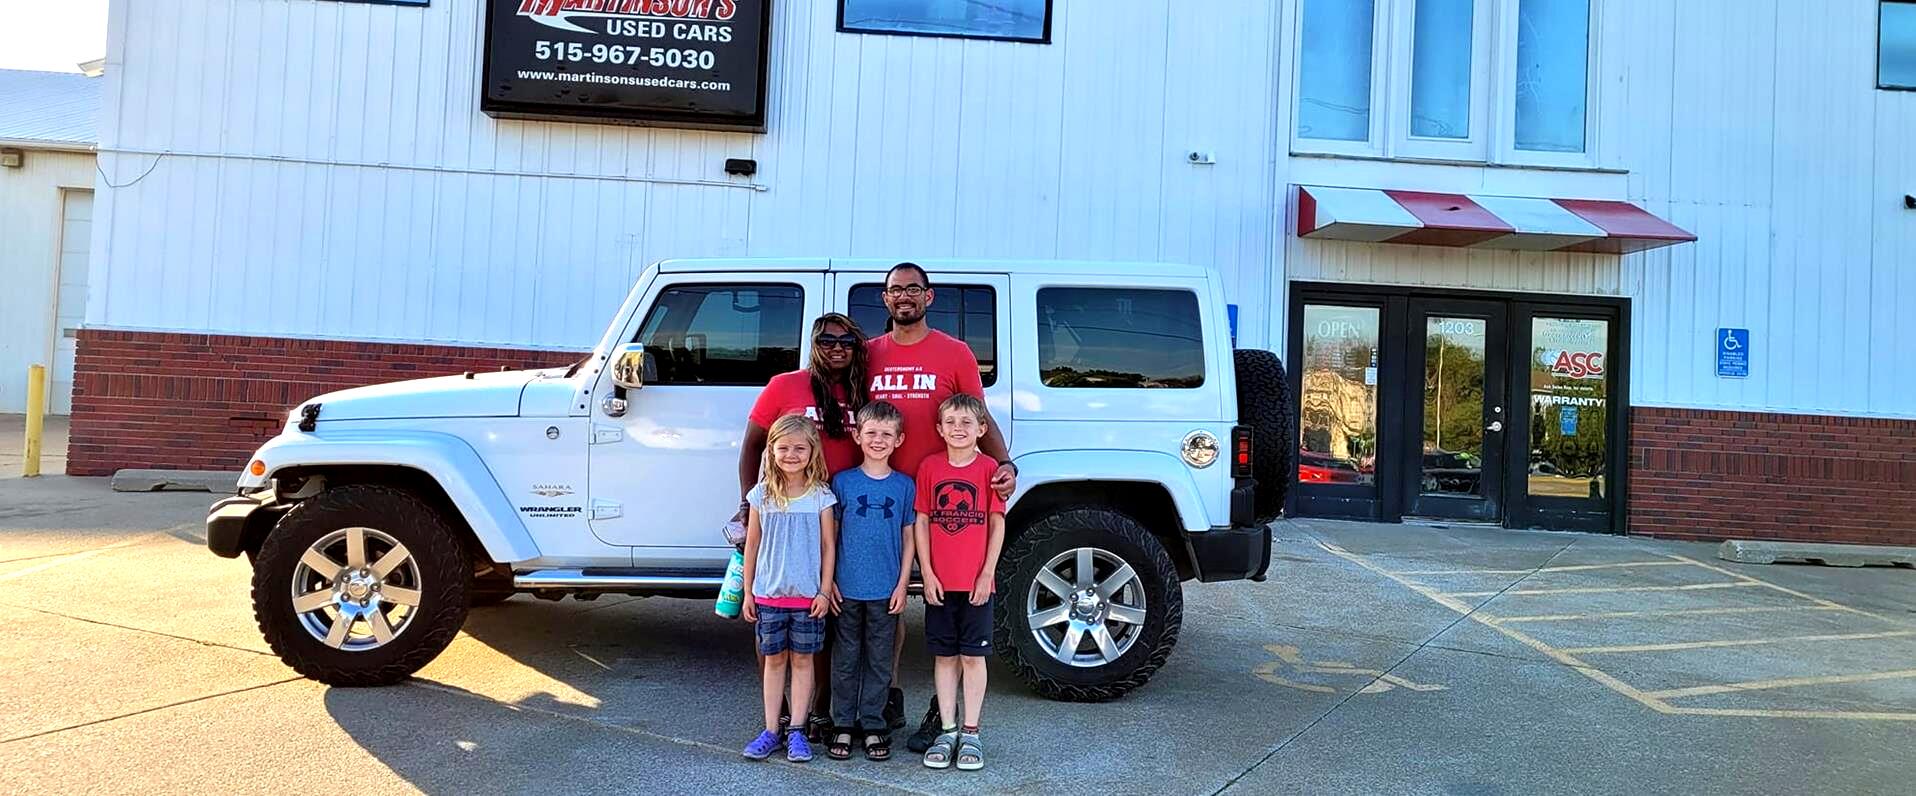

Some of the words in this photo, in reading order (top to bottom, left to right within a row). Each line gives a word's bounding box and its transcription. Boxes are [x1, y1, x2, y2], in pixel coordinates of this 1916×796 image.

[516, 0, 737, 20] MARTINSONS
[606, 19, 666, 38] USED
[673, 22, 733, 42] CARS
[535, 40, 715, 70] 515-967-5030
[517, 69, 731, 91] www.martinsonsusedcars.com
[1318, 320, 1361, 338] OPEN
[1552, 349, 1604, 379] ASC
[870, 374, 908, 392] ALL
[913, 374, 936, 390] IN
